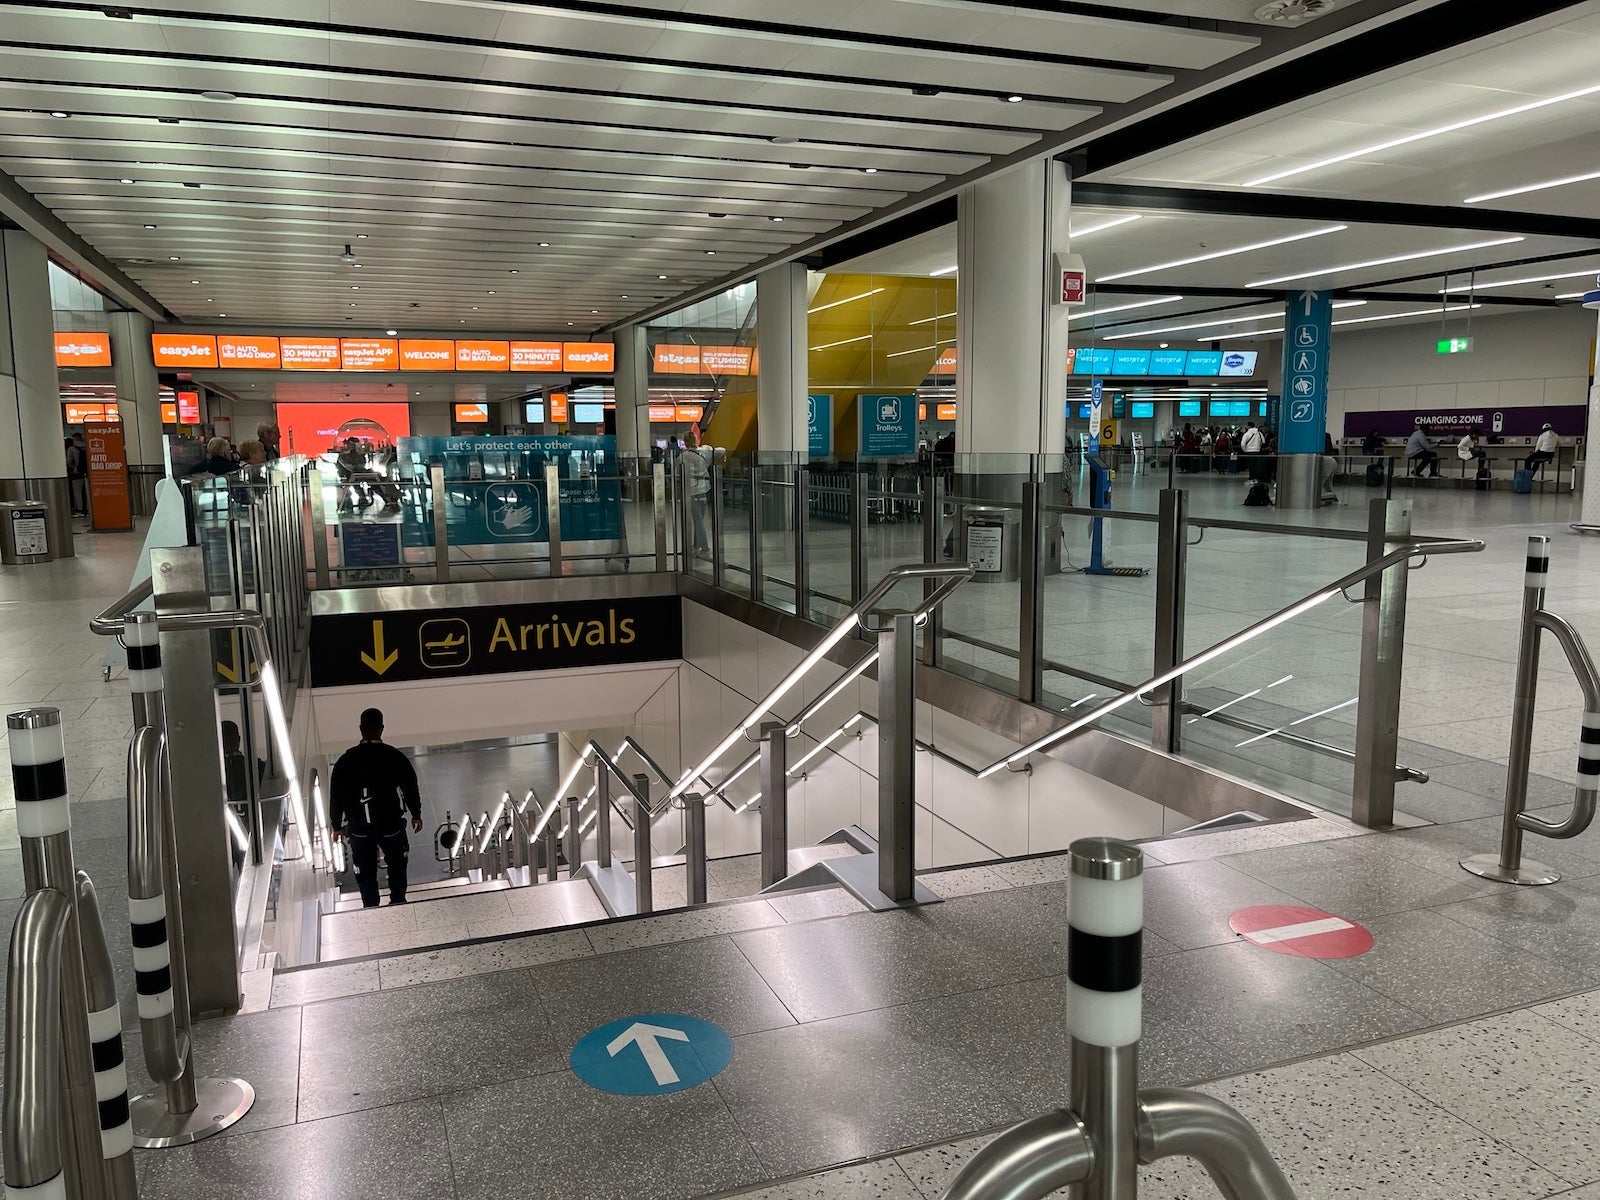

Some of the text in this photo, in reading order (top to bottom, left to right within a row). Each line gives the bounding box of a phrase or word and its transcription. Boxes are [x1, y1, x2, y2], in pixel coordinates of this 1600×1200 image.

[159, 345, 211, 357] easyJet
[297, 350, 337, 358] MINUTES
[404, 351, 450, 360] WELCOME
[568, 352, 609, 363] easyJet
[1414, 415, 1484, 424] CHARGING ZONE
[88, 427, 120, 435] easyJet
[876, 424, 903, 432] Trolleys
[1103, 425, 1113, 440] 6
[446, 439, 573, 452] Let's protect each other
[91, 454, 107, 462] AUTO
[91, 462, 123, 470] BAG DROP
[489, 609, 636, 653] Arrivals
